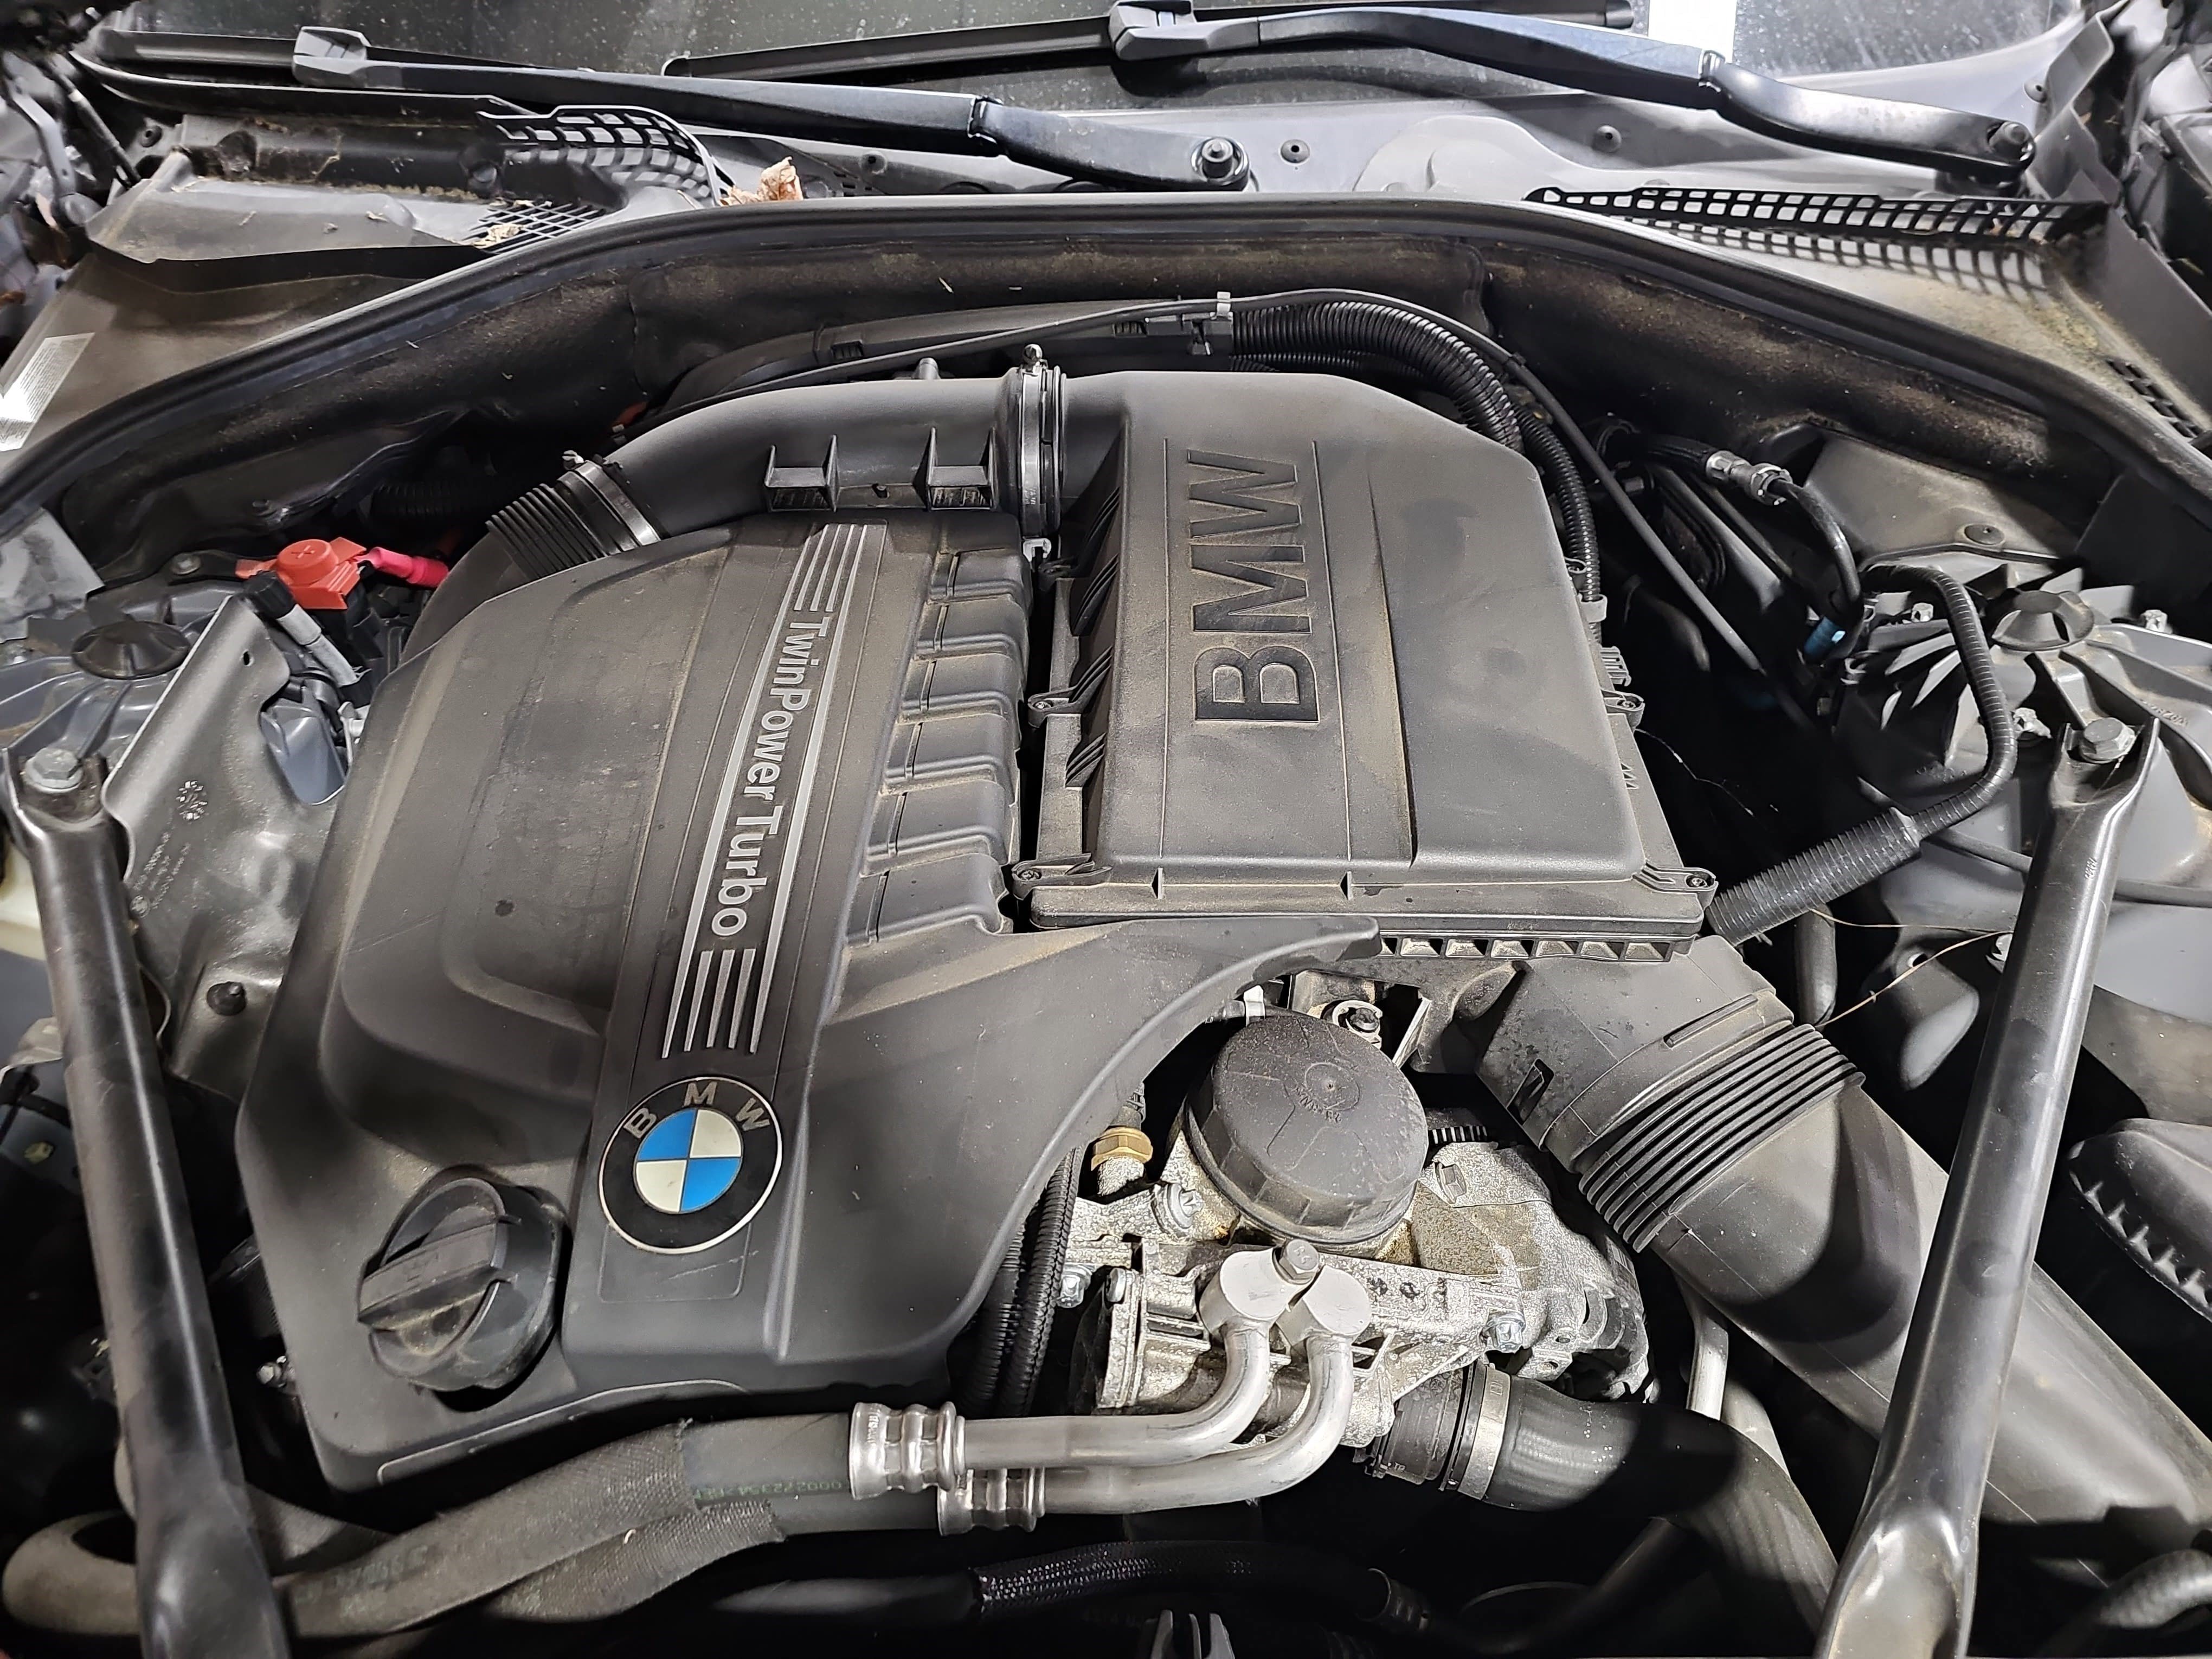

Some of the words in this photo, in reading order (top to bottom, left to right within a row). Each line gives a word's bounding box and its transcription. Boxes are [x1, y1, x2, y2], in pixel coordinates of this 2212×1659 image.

[1188, 448, 1320, 723] BMW
[743, 616, 830, 801] TwinPower
[711, 805, 785, 937] Turbo
[623, 1081, 770, 1139] BMW
